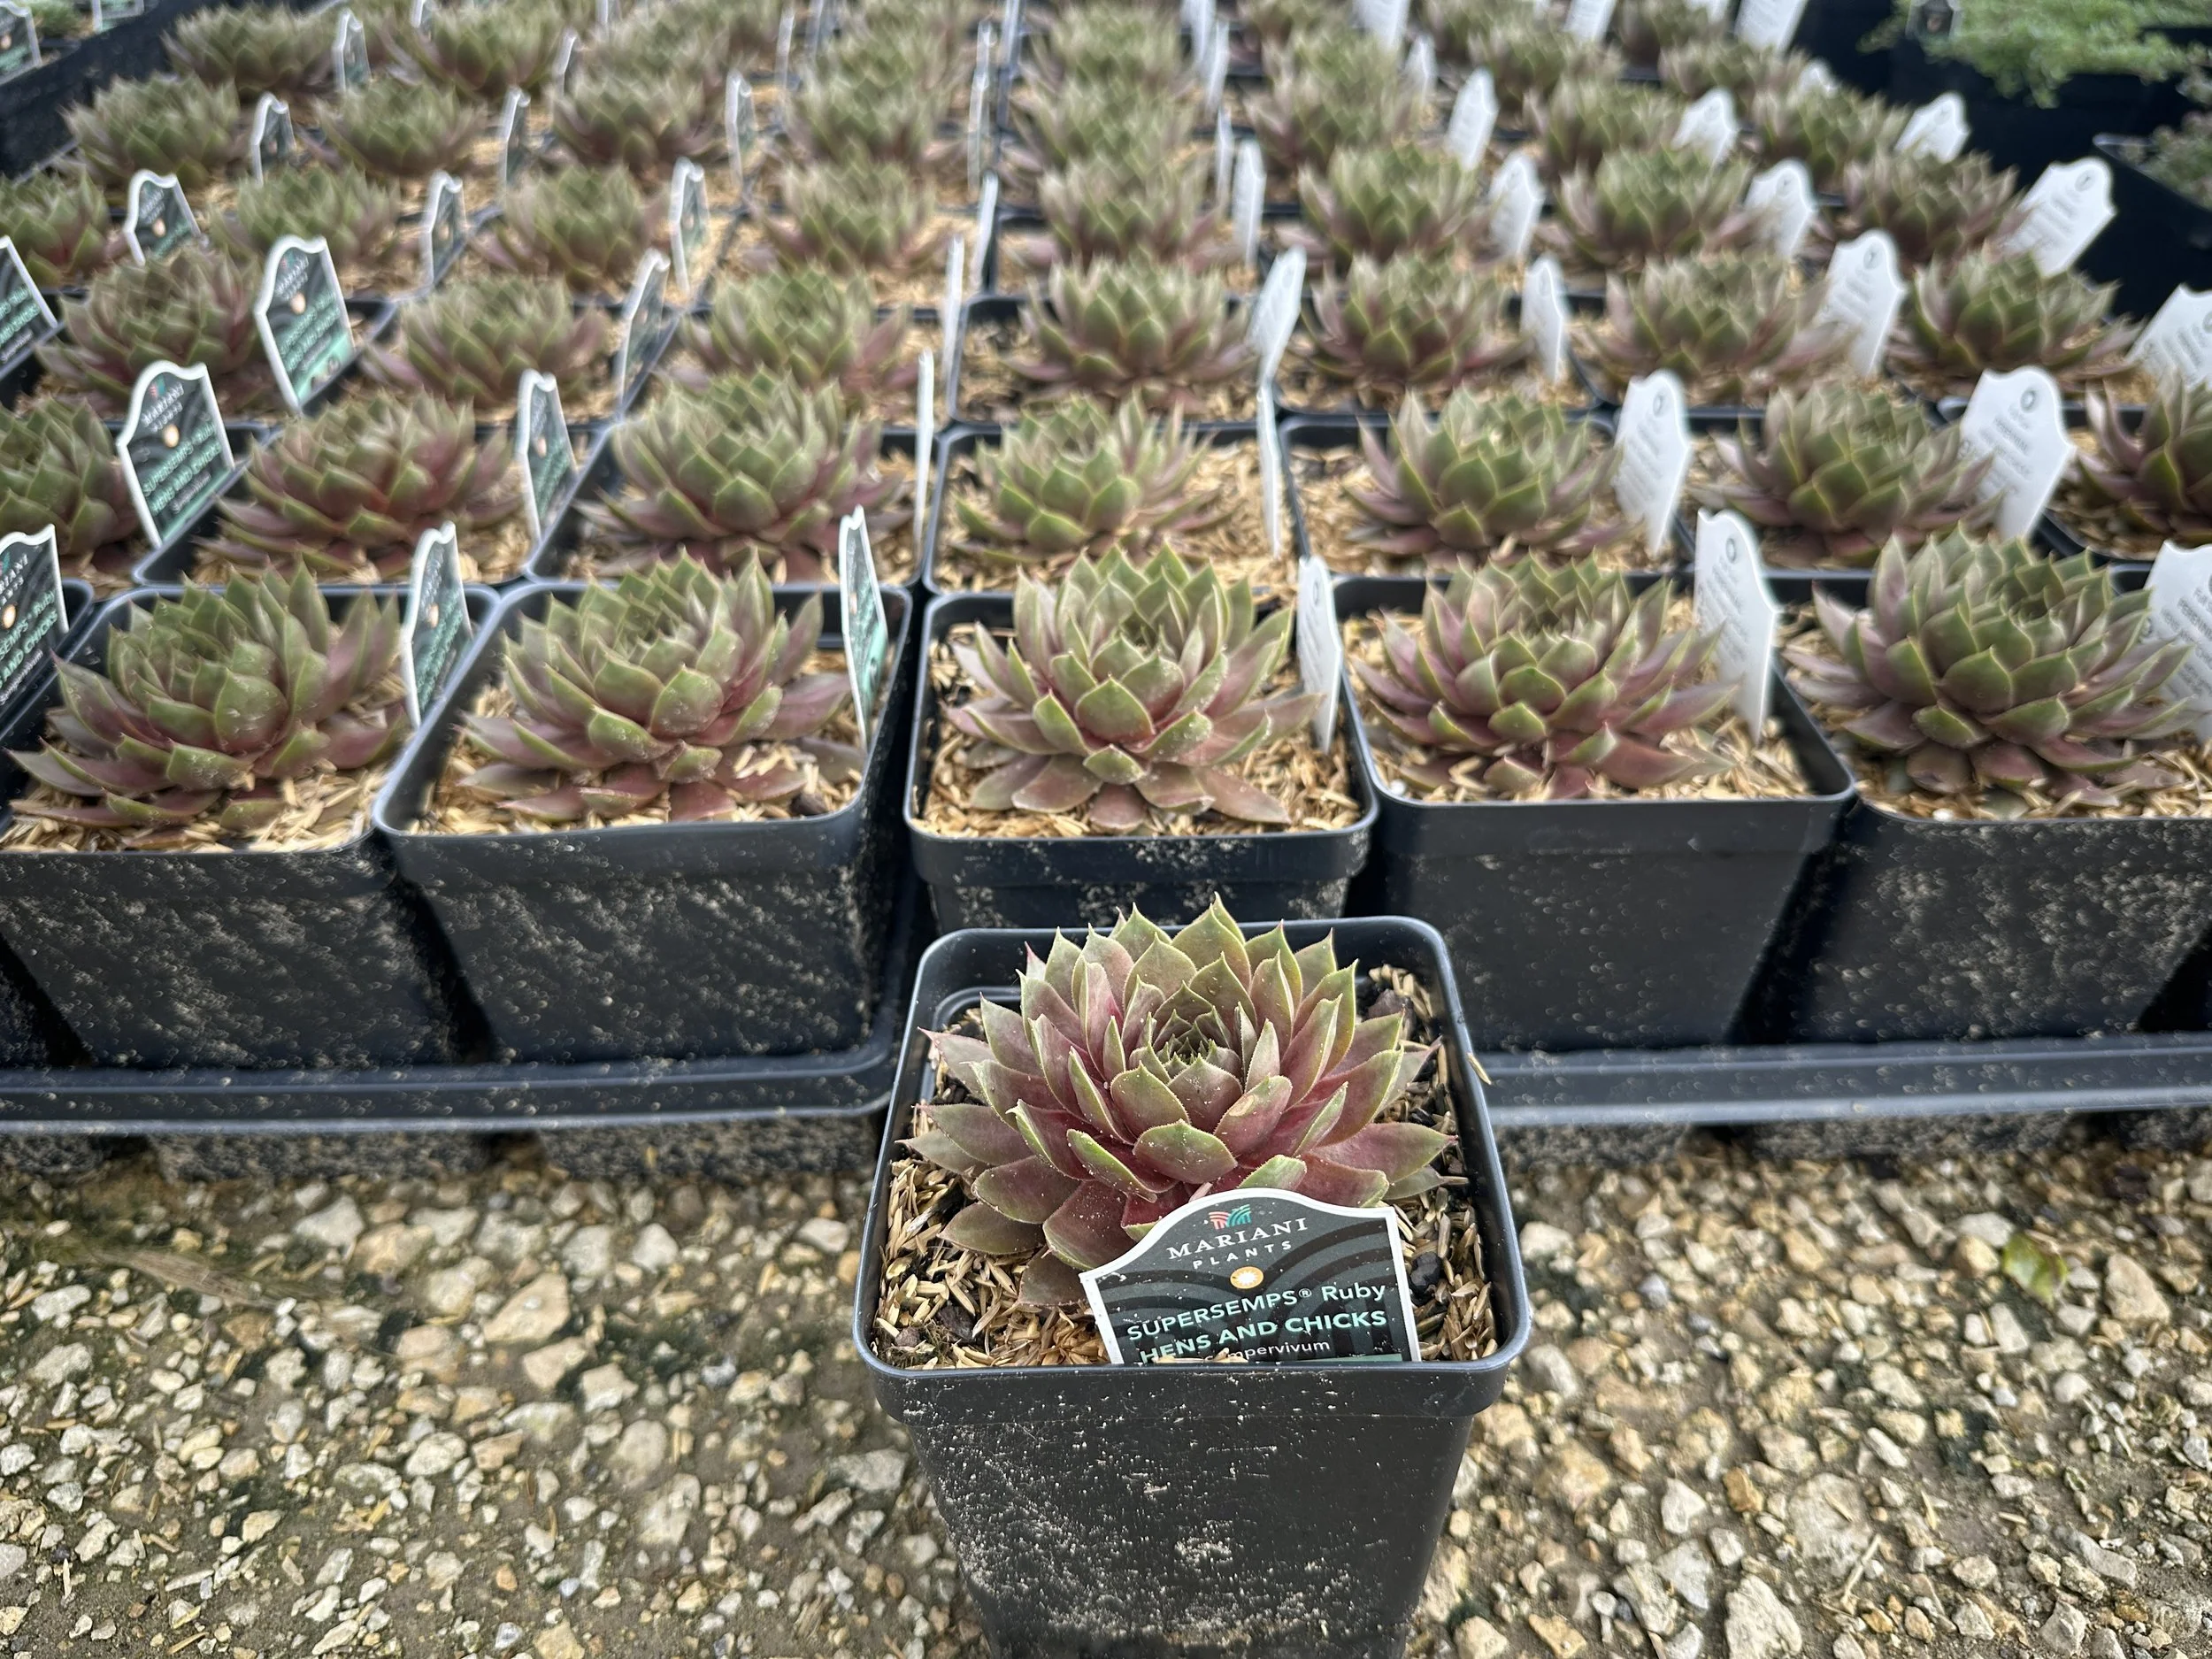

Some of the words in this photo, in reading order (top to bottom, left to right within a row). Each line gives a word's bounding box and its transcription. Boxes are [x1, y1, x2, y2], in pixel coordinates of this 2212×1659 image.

[1167, 1217, 1310, 1261] MARIANI
[1192, 1240, 1294, 1270] PLANTS
[1320, 1282, 1386, 1302] Ruby
[1139, 1334, 1211, 1364] HENS
[1218, 1319, 1278, 1345] AND
[1284, 1310, 1387, 1333] CHICKS
[1204, 1340, 1331, 1361] mpervivum
